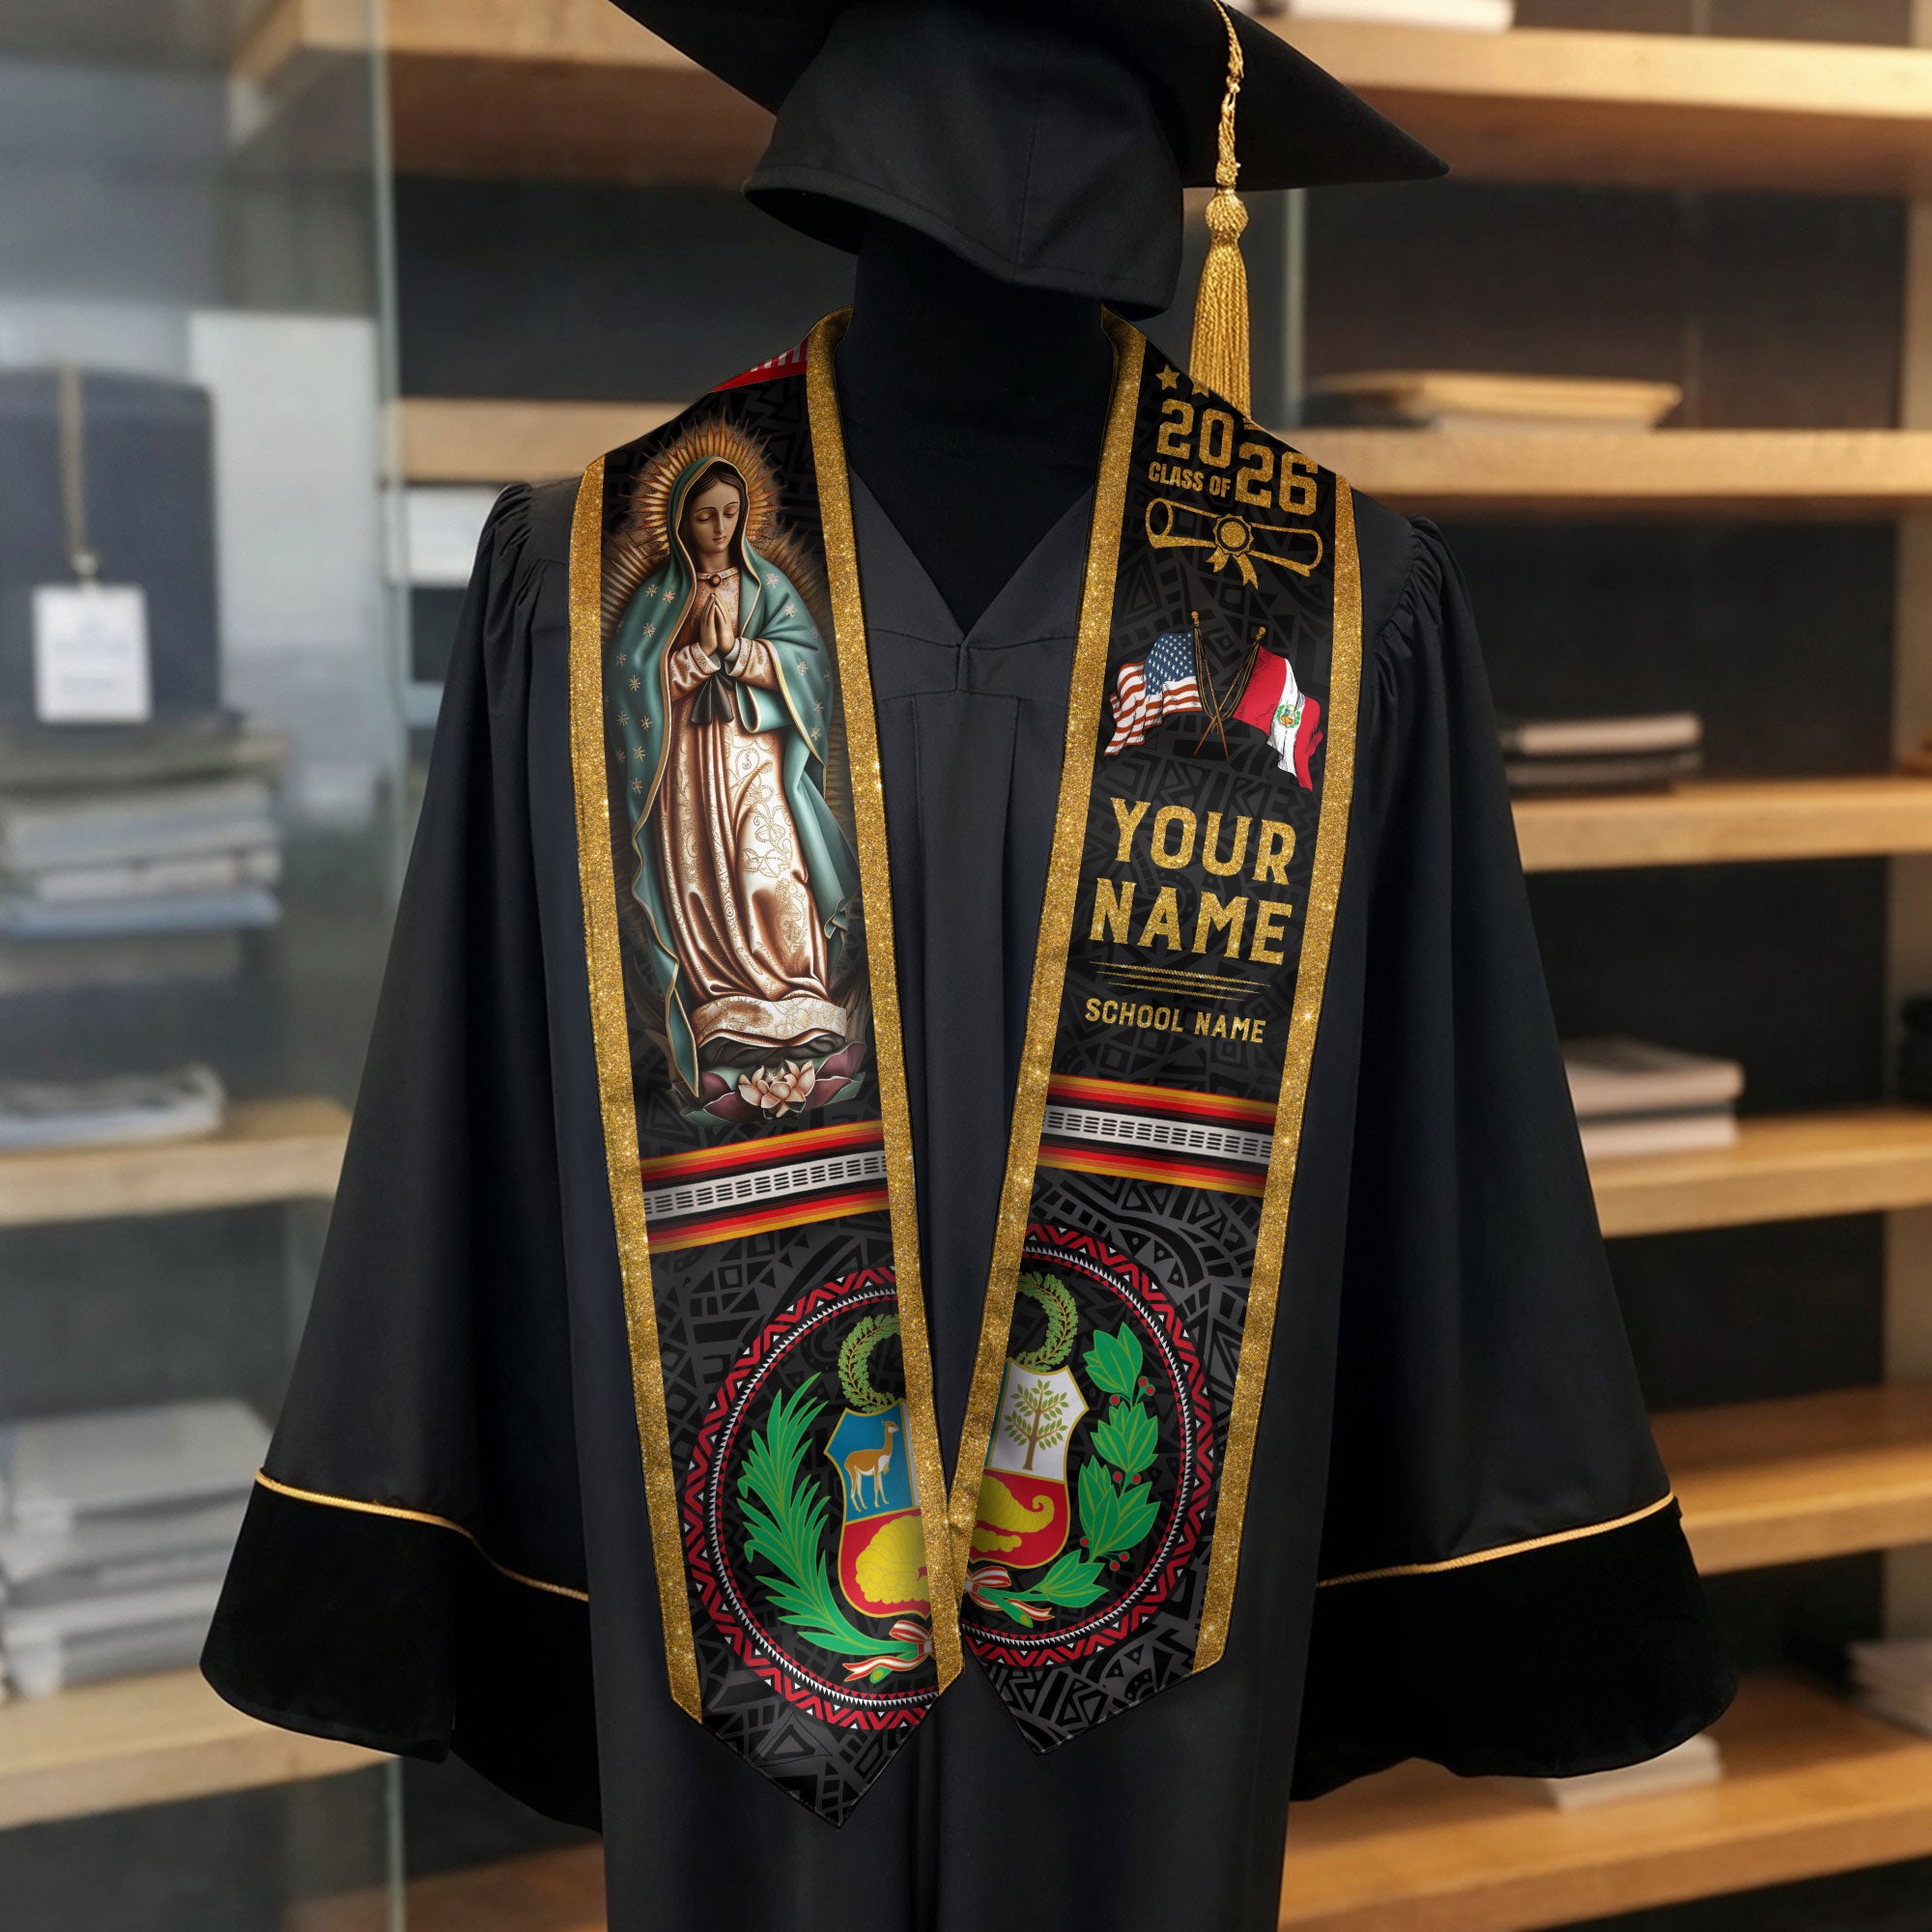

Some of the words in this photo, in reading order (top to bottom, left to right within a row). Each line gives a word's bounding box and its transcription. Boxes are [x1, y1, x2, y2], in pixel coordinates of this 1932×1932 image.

[1149, 462, 1204, 493] CLASS
[1209, 475, 1232, 499] OF
[1157, 399, 1318, 516] 2026
[1110, 798, 1296, 885] YOUR
[1089, 877, 1293, 965] NAME
[1085, 998, 1183, 1032] SCHOOL
[1194, 1011, 1265, 1043] NAME
